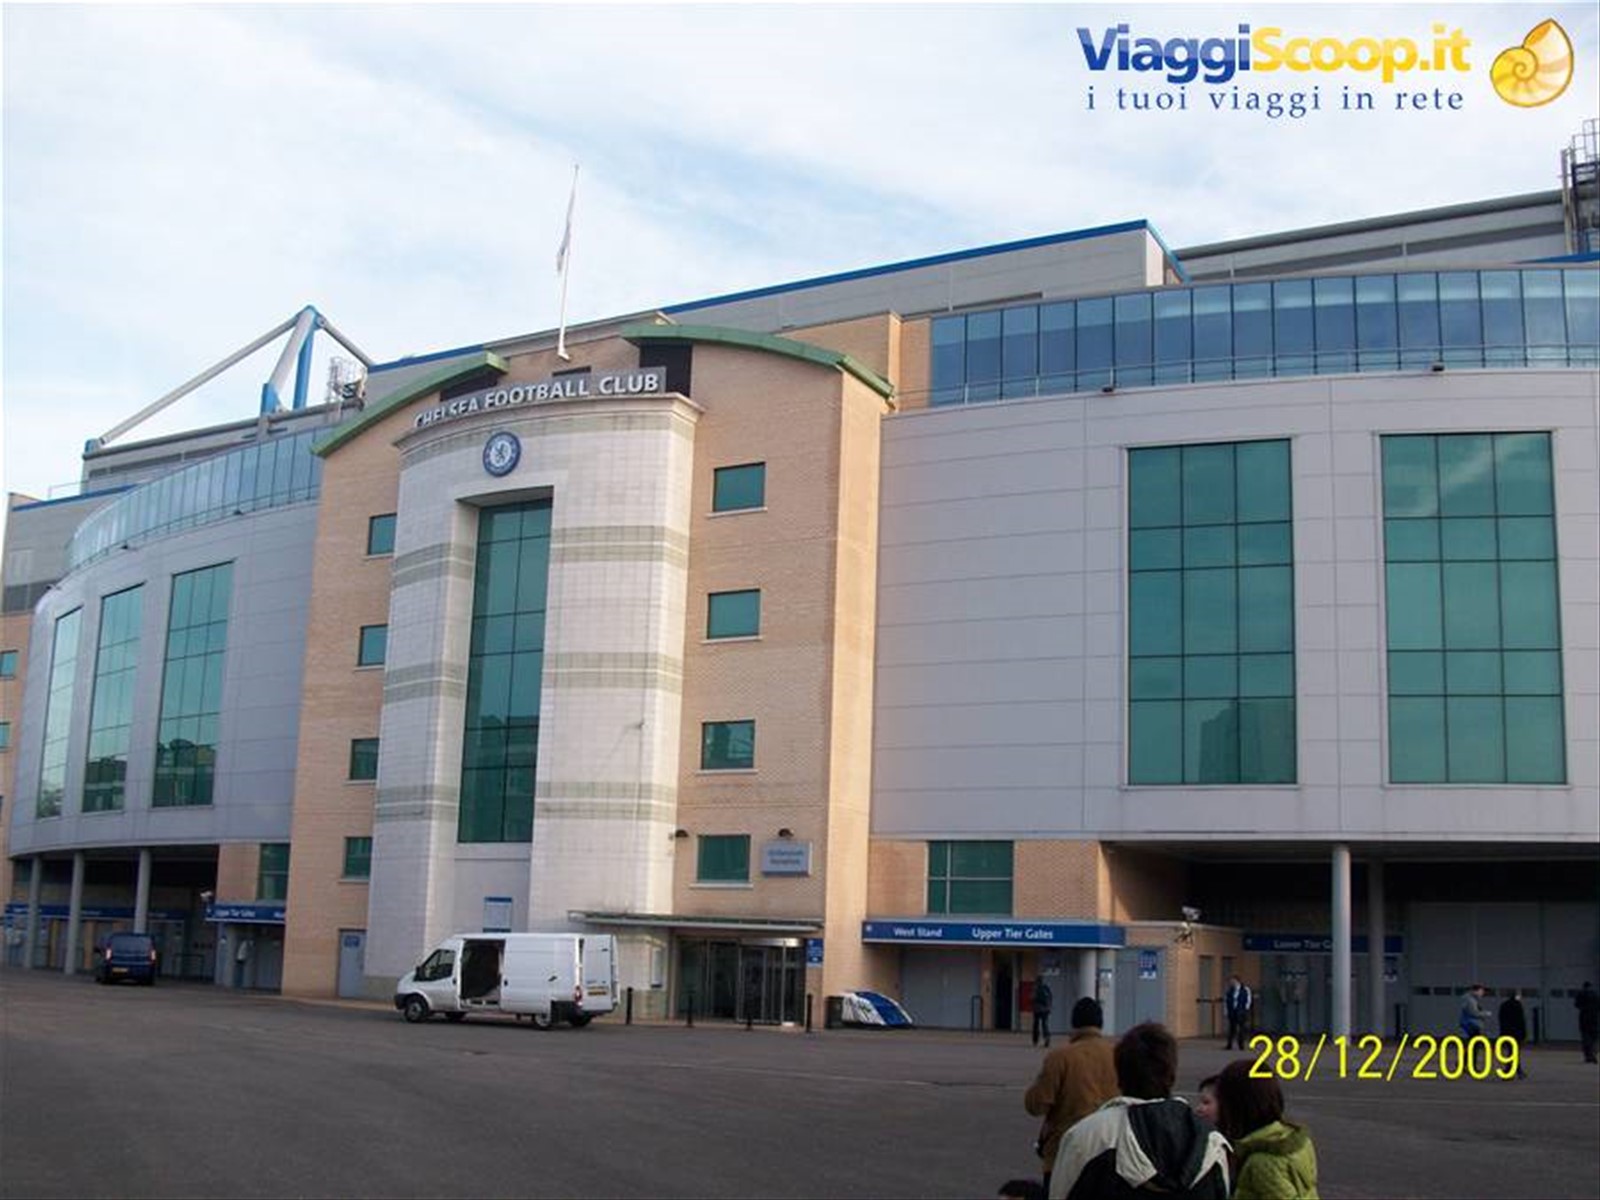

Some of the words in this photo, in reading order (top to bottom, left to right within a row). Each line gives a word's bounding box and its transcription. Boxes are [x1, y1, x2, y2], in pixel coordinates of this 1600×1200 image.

[414, 398, 479, 427] CHELSEA
[484, 379, 590, 408] FOOTBALL
[599, 373, 659, 395] CLUB
[893, 927, 915, 937] West
[917, 927, 943, 938] Stand
[972, 928, 1002, 941] Upper
[1004, 928, 1023, 939] Tier
[1025, 928, 1054, 940] Gates
